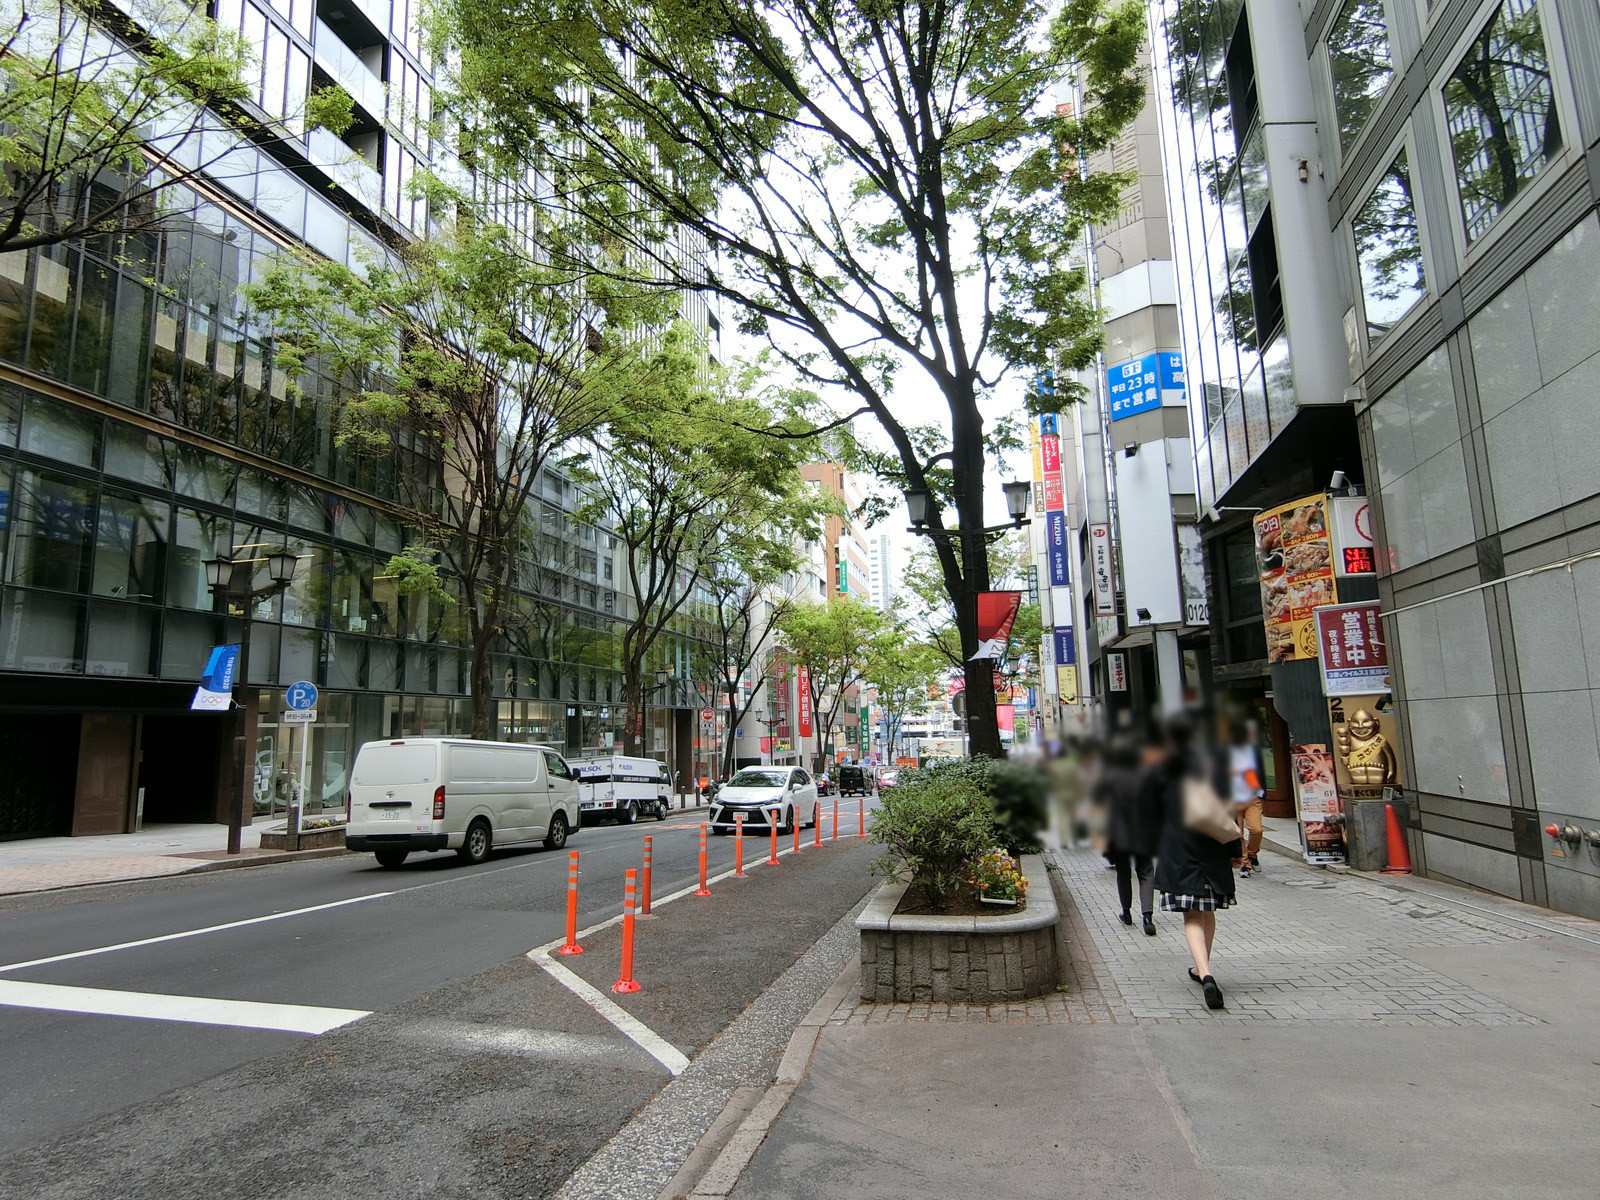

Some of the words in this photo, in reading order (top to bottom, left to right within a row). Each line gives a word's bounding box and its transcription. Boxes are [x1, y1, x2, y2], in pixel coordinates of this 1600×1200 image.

[1123, 363, 1139, 376] 5F
[1113, 387, 1157, 411] まで営業
[1053, 515, 1062, 546] MIZUHO
[1094, 529, 1105, 537] 3F
[1341, 611, 1366, 665] 営業中
[1328, 629, 1341, 667] 夜9時まで
[225, 656, 235, 675] TOKYO
[223, 675, 231, 689] 2020
[292, 689, 306, 707] P
[1330, 697, 1345, 723] 2階
[1324, 790, 1335, 798] 6F
